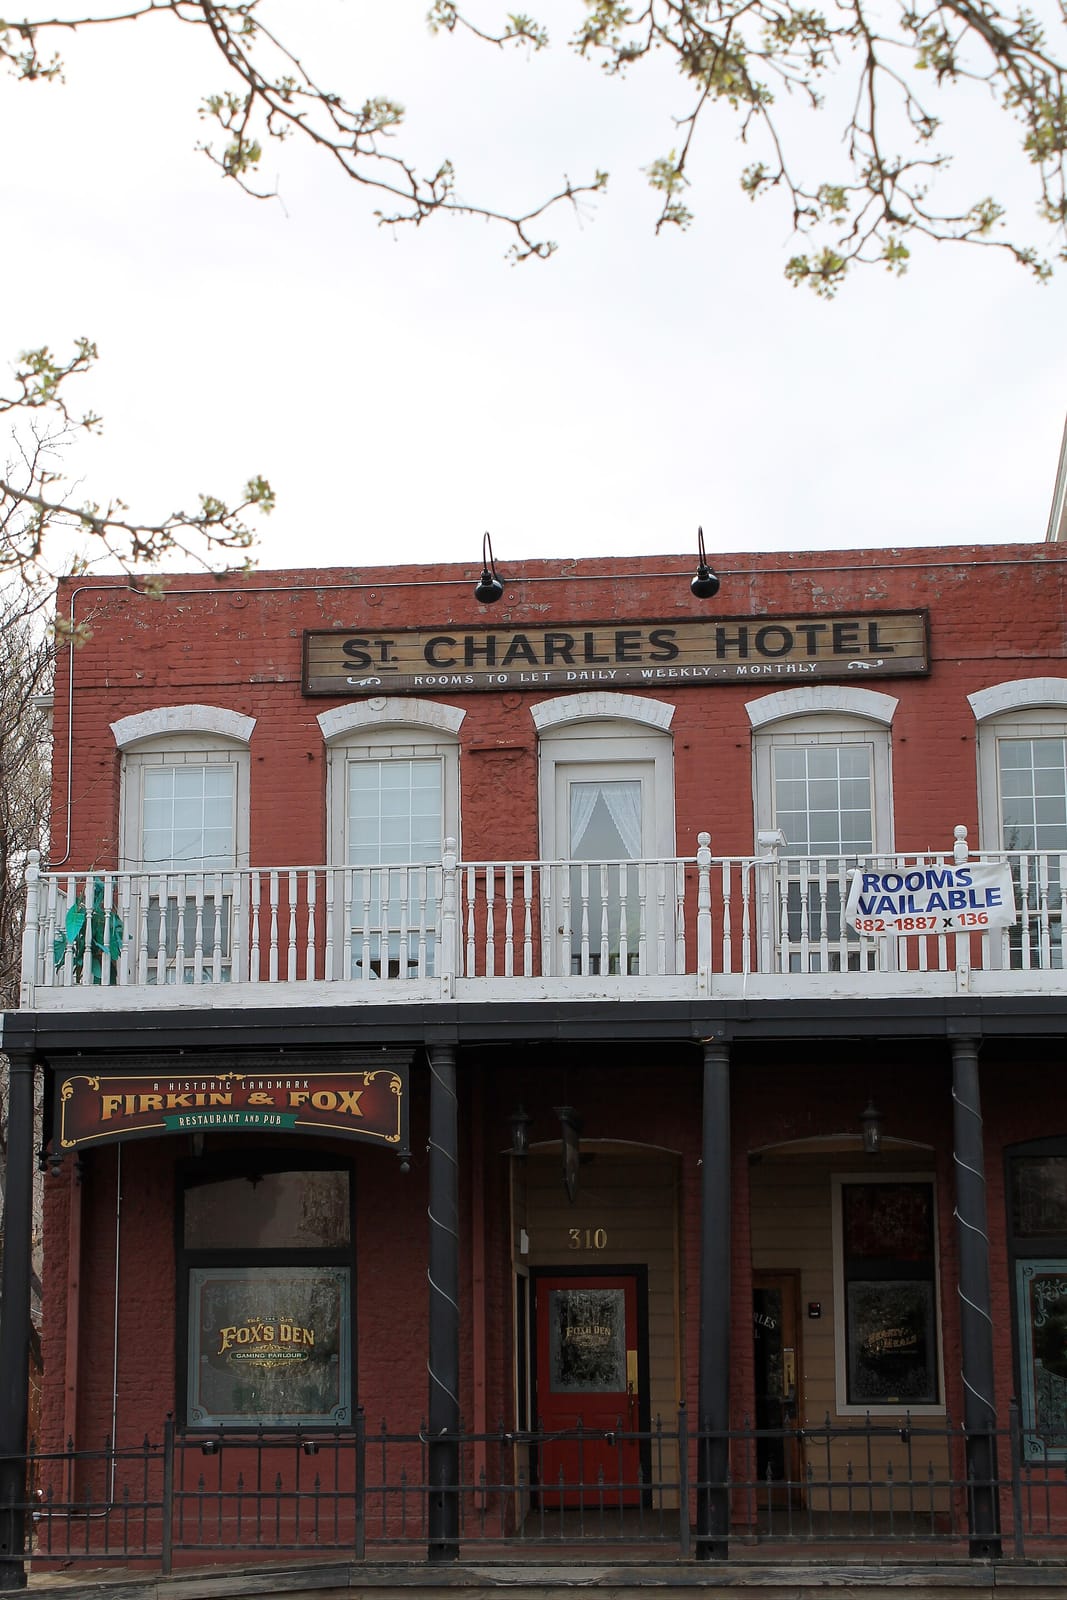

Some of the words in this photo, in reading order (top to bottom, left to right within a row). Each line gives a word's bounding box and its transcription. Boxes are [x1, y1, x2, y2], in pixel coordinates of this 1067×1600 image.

[423, 629, 679, 667] CHARLES
[715, 622, 894, 658] HOTEL
[414, 675, 474, 685] ROOMS
[486, 674, 508, 684] TO
[520, 671, 552, 682] LET
[566, 670, 617, 681] DAILY
[641, 667, 711, 679] WEEKLY
[736, 663, 818, 675] MONTHLY
[861, 867, 973, 893] ROOMS
[856, 887, 1003, 916] VAILABLE
[957, 912, 989, 926] 136
[153, 1082, 160, 1091] A
[169, 1081, 231, 1091] HISTORIC
[242, 1080, 309, 1089] LANDMARK
[101, 1091, 234, 1121] FIRKIN
[247, 1092, 276, 1106] &
[289, 1090, 364, 1117] FOX
[179, 1113, 240, 1126] RESTAURANT
[244, 1115, 260, 1123] AND
[263, 1114, 282, 1125] PUB
[568, 1228, 608, 1249] 310
[217, 1323, 275, 1354] FOX'S
[280, 1324, 315, 1345] DEN
